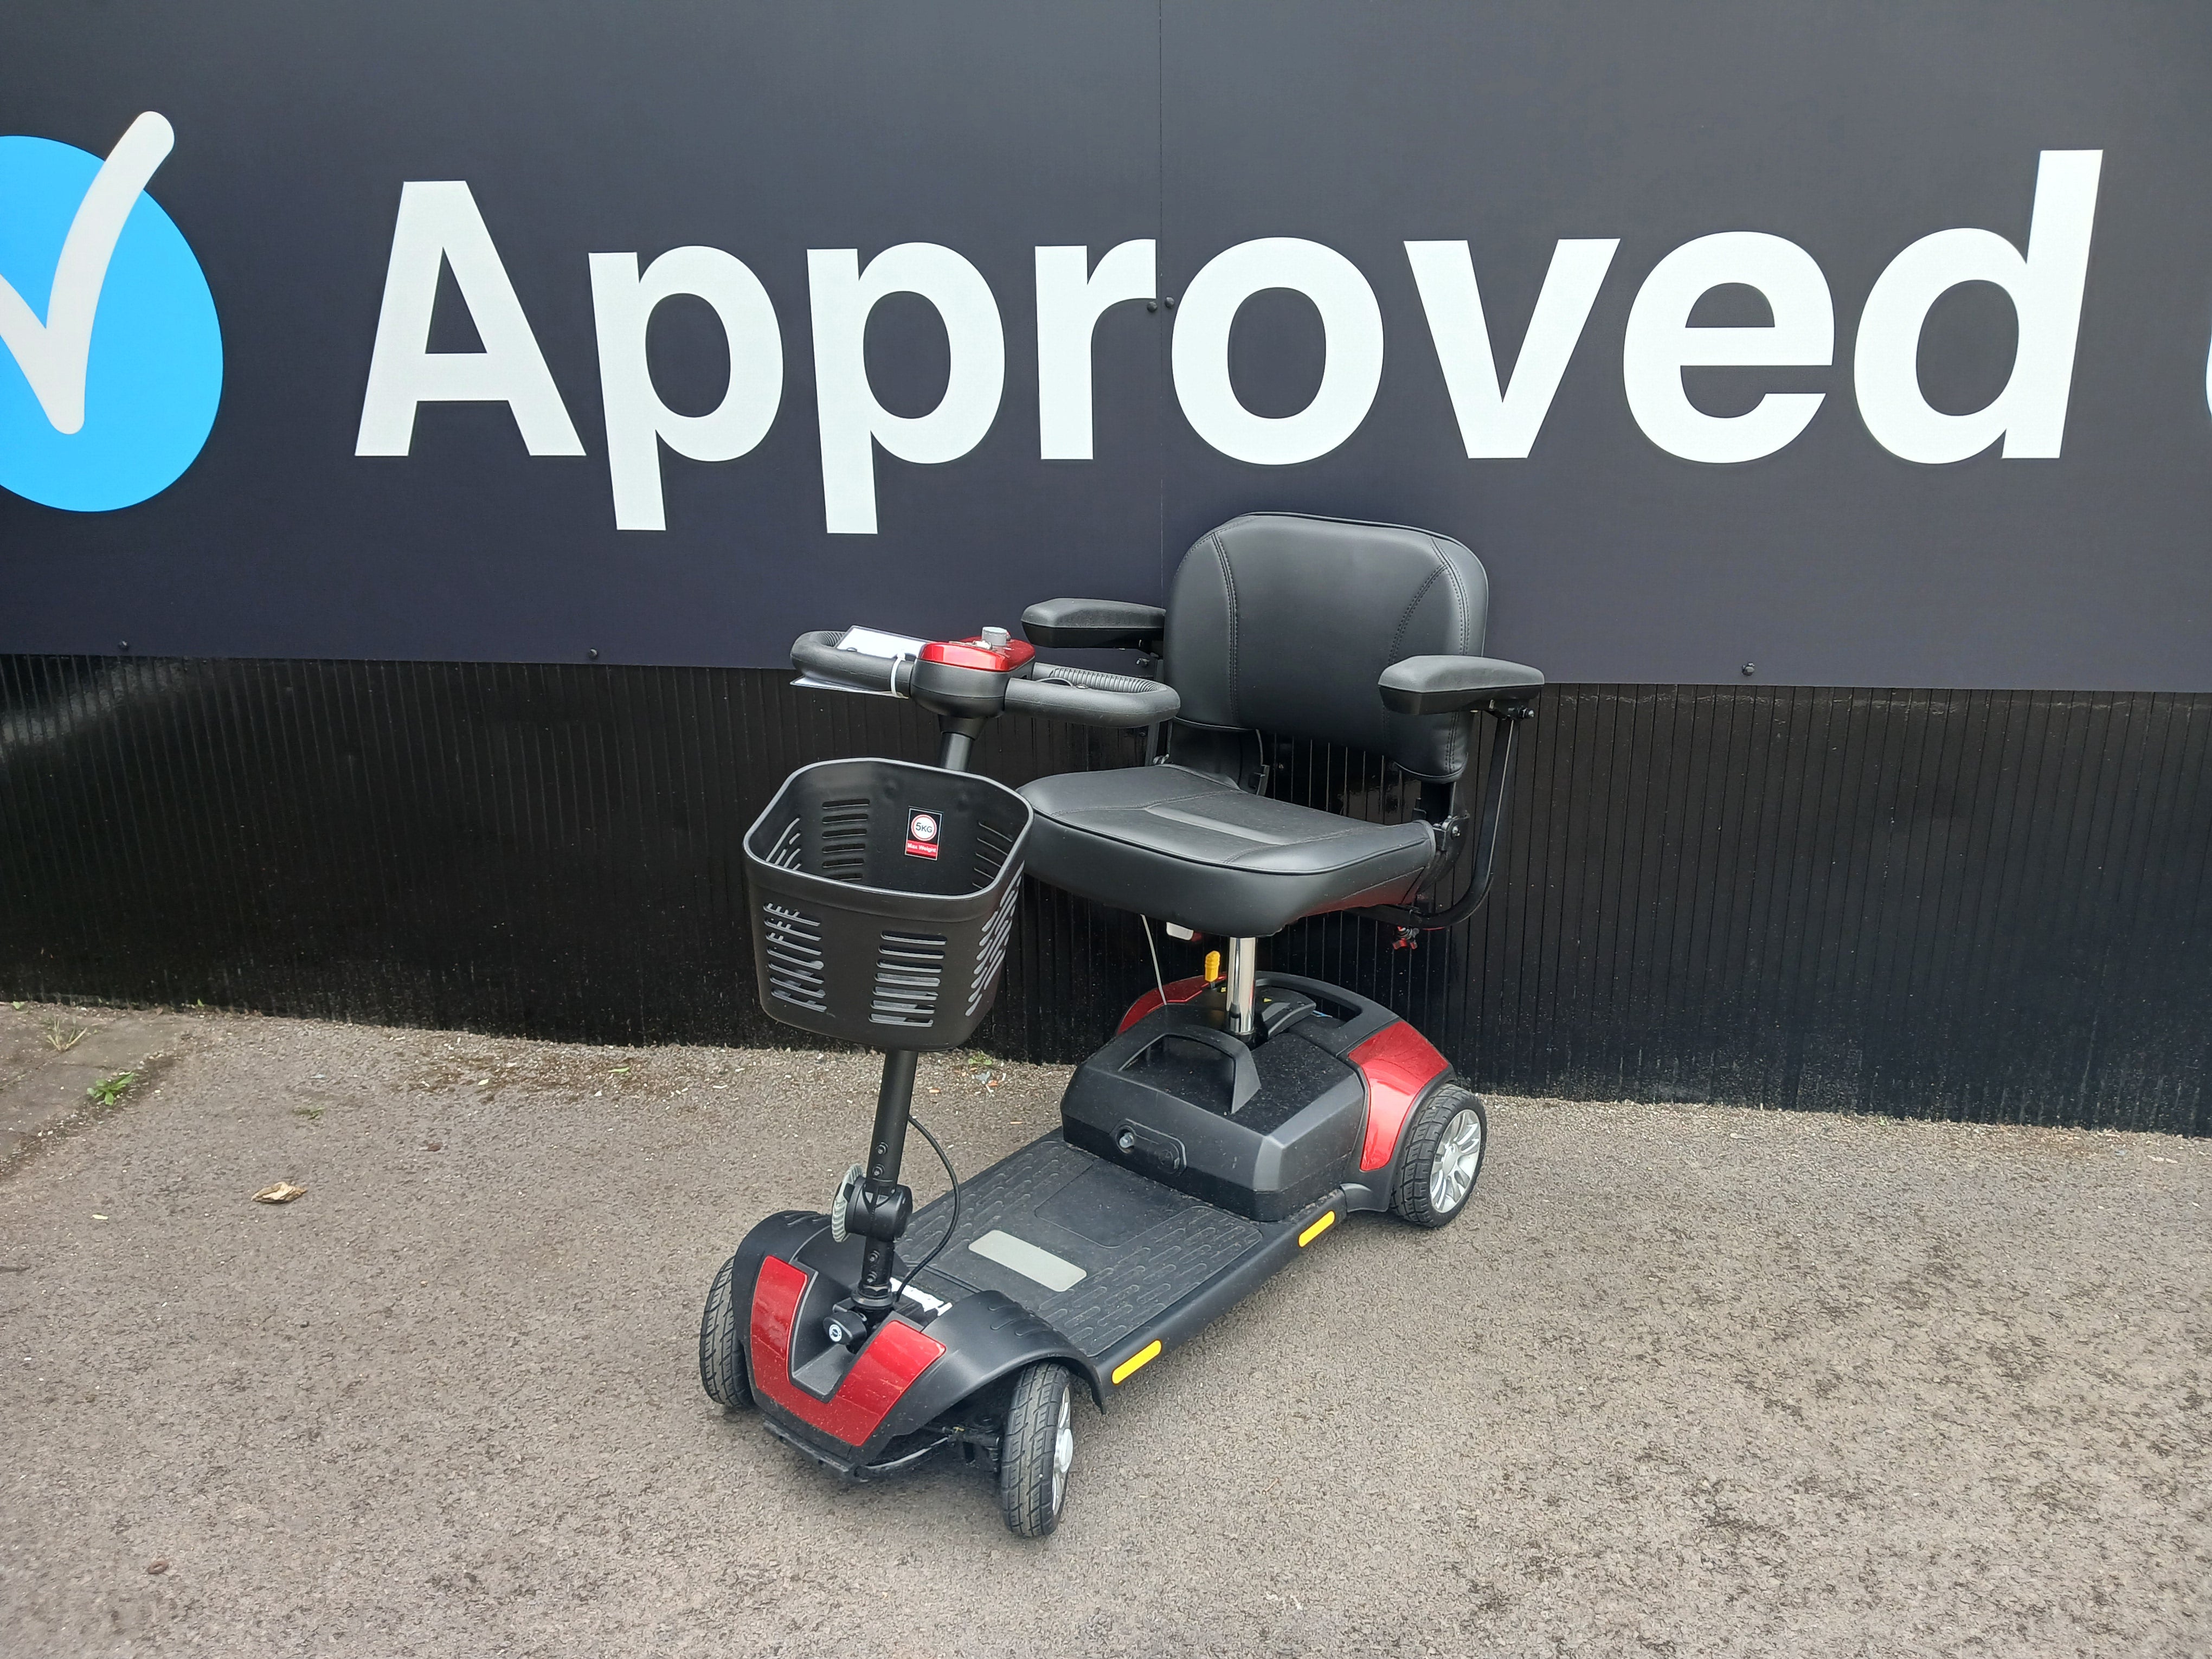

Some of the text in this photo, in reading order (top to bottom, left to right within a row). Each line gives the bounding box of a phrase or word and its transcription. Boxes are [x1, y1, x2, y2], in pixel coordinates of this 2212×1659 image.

[354, 149, 2104, 535] Approved
[916, 822, 933, 833] 5KG
[919, 845, 936, 853] Weight
